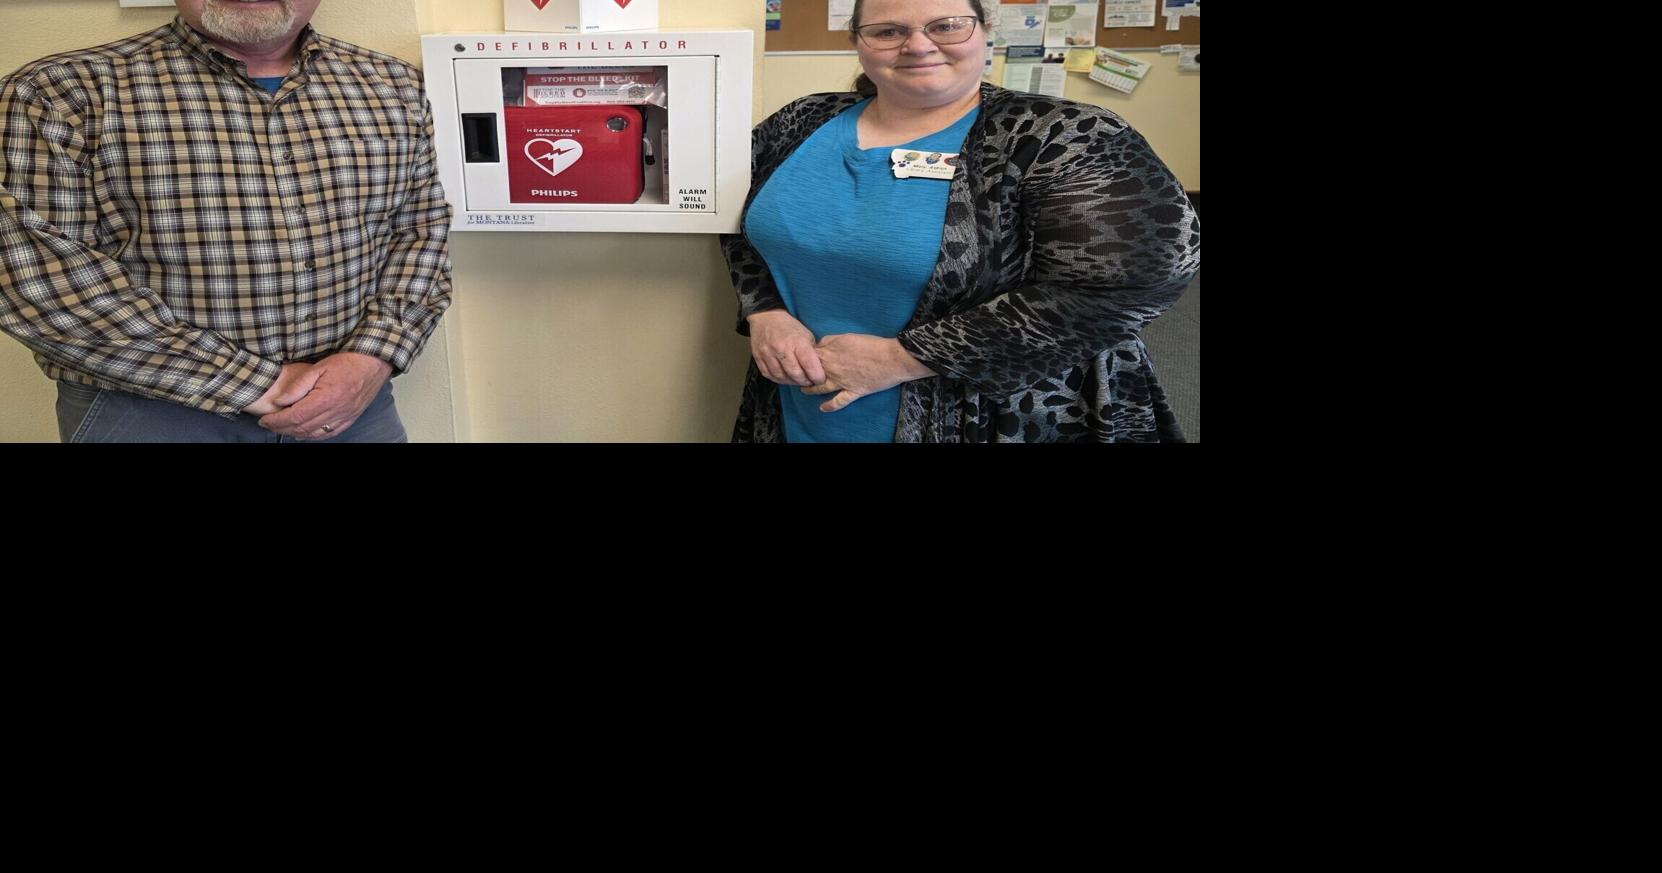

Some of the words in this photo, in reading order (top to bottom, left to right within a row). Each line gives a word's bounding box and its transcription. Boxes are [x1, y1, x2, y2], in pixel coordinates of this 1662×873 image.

[477, 40, 687, 52] DEFIBRILLATOR
[567, 75, 586, 83] THE
[531, 189, 579, 197] PHILIPS
